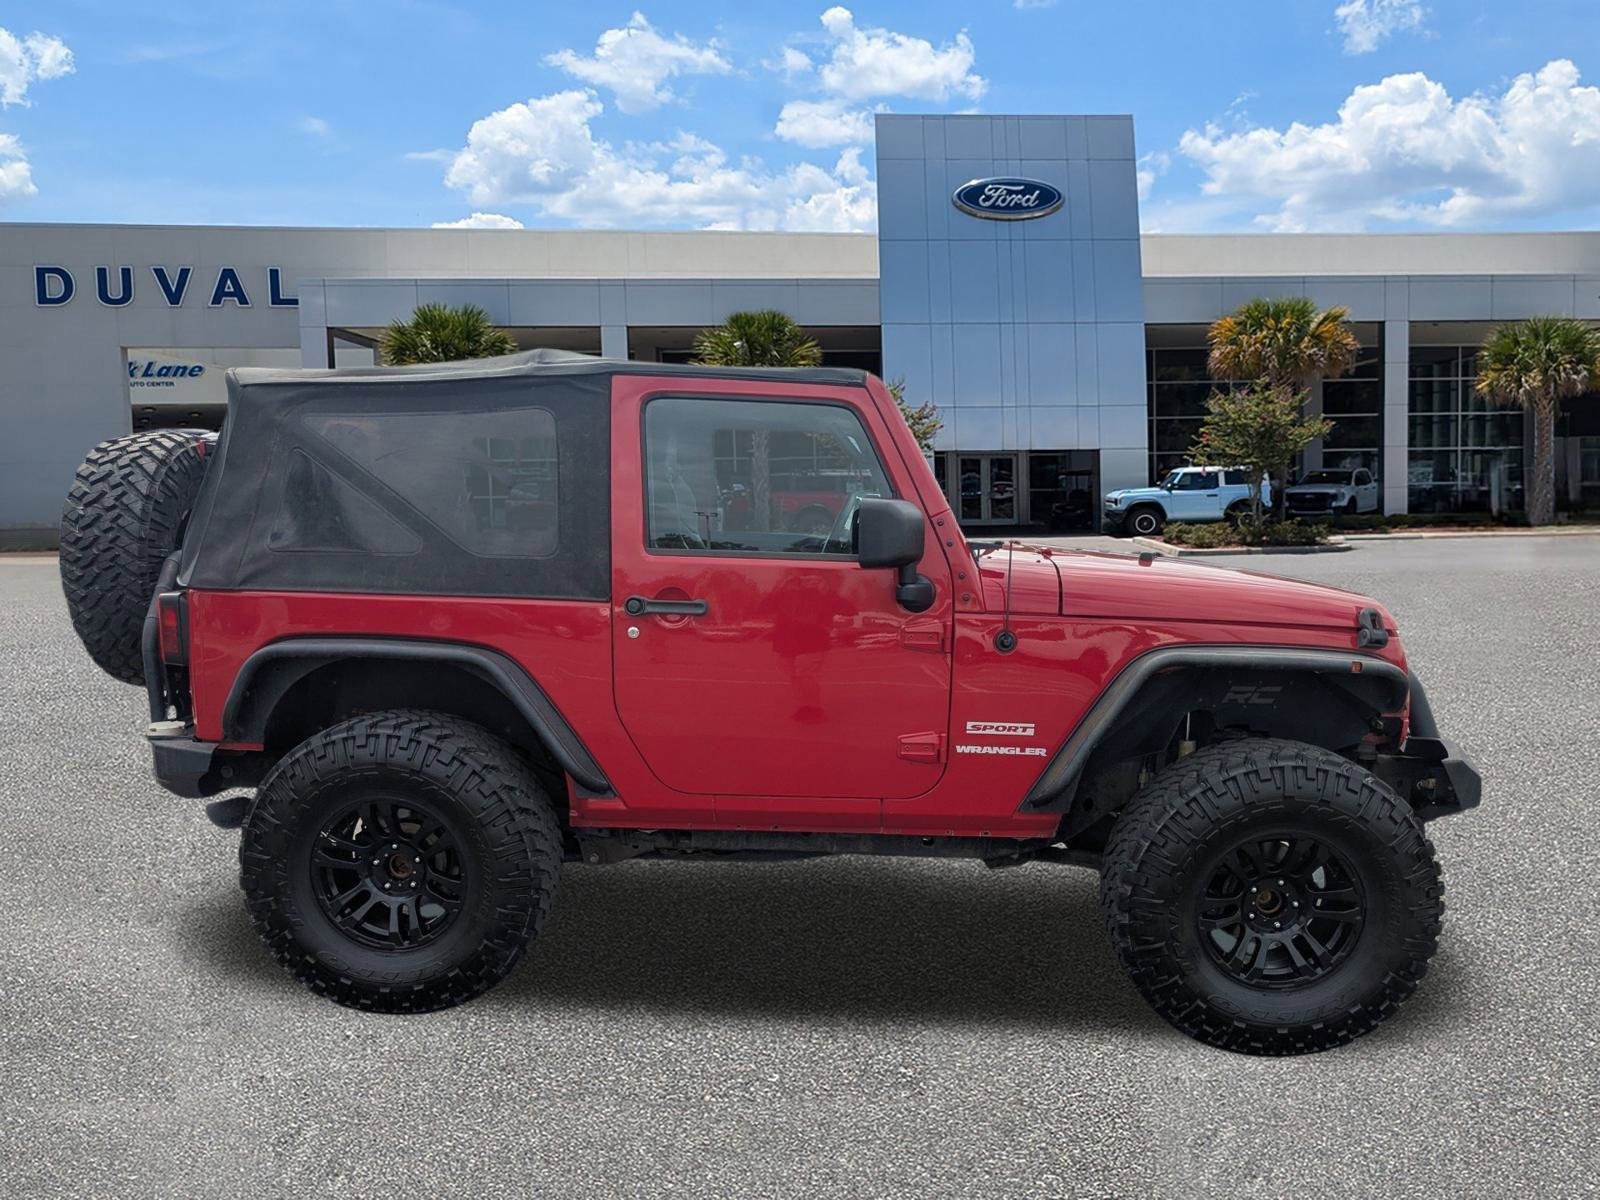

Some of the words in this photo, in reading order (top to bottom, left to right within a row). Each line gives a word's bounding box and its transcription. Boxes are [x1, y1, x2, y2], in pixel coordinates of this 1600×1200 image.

[979, 184, 1040, 207] Ford
[33, 265, 299, 307] DUVAL
[142, 361, 205, 378] Lane
[967, 723, 1035, 734] SPORT
[956, 745, 1047, 757] WRANGLER
